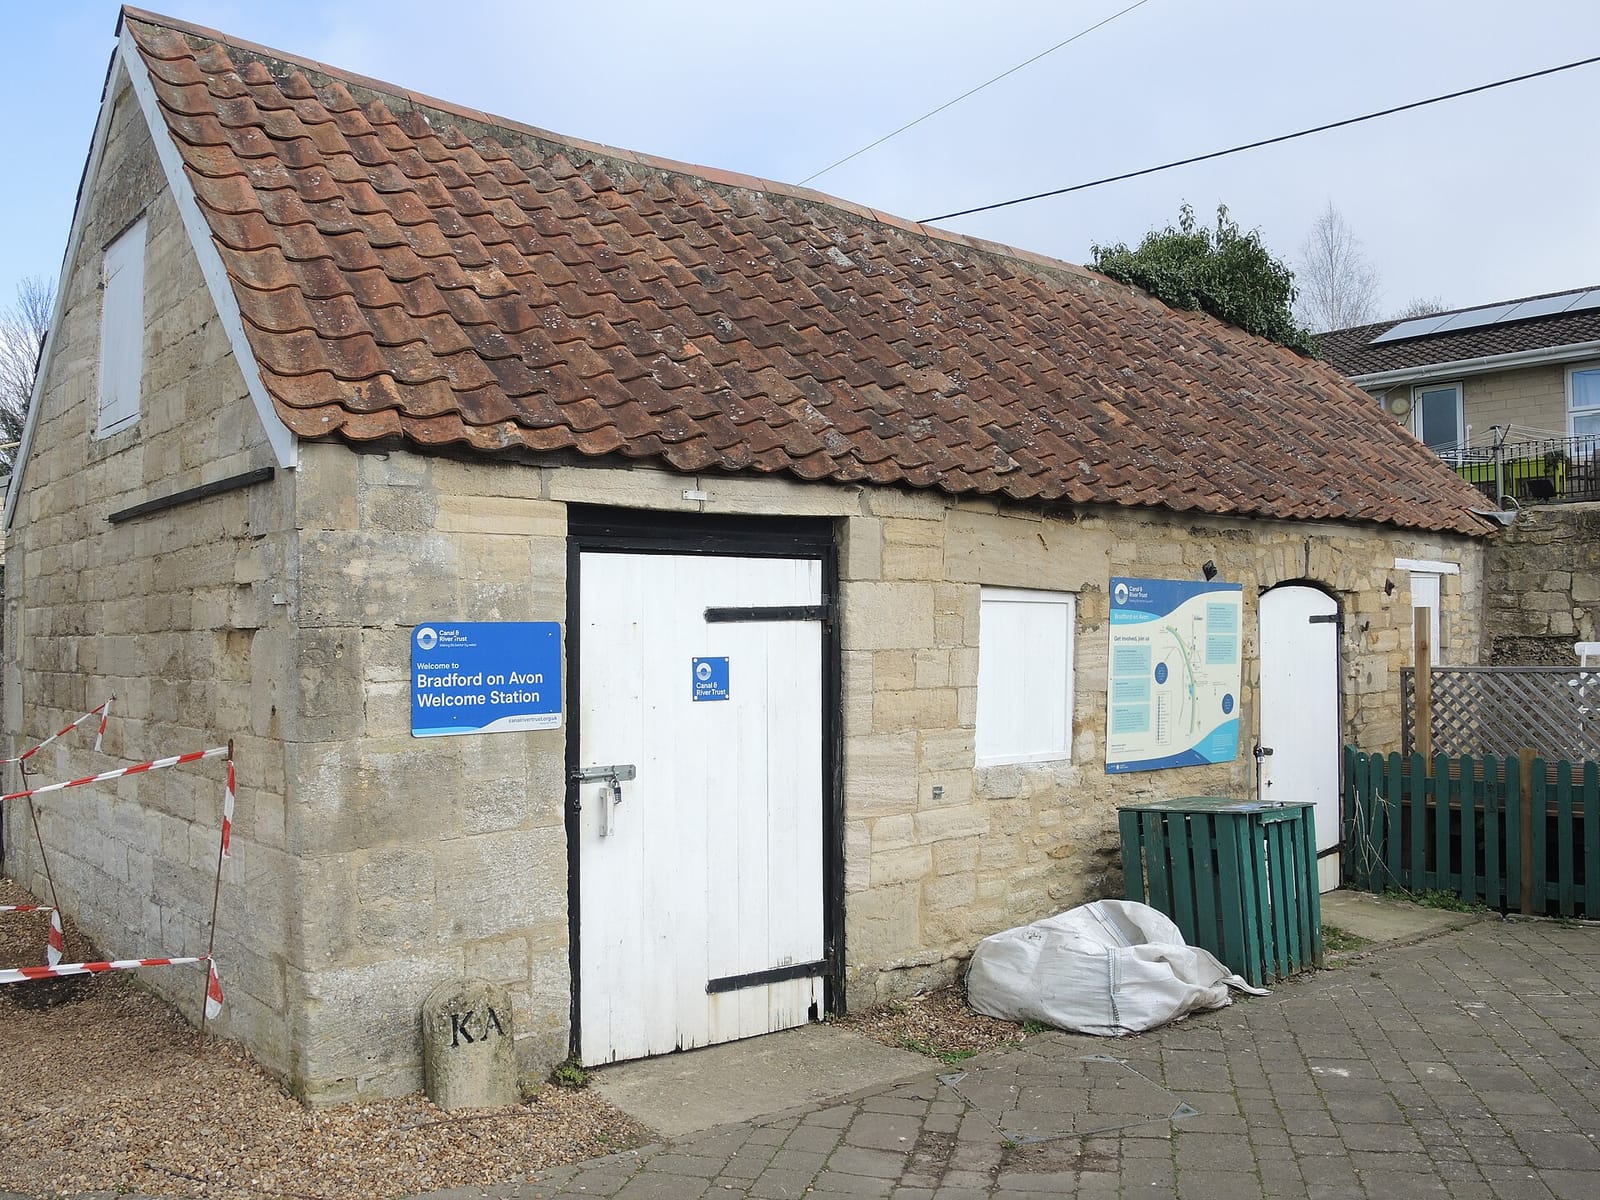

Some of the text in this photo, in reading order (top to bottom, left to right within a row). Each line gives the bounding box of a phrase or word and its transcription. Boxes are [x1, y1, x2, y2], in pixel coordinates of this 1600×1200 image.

[417, 672, 543, 688] Bradford on Avon
[417, 690, 540, 708] Welcome Station
[450, 1007, 506, 1048] KA
